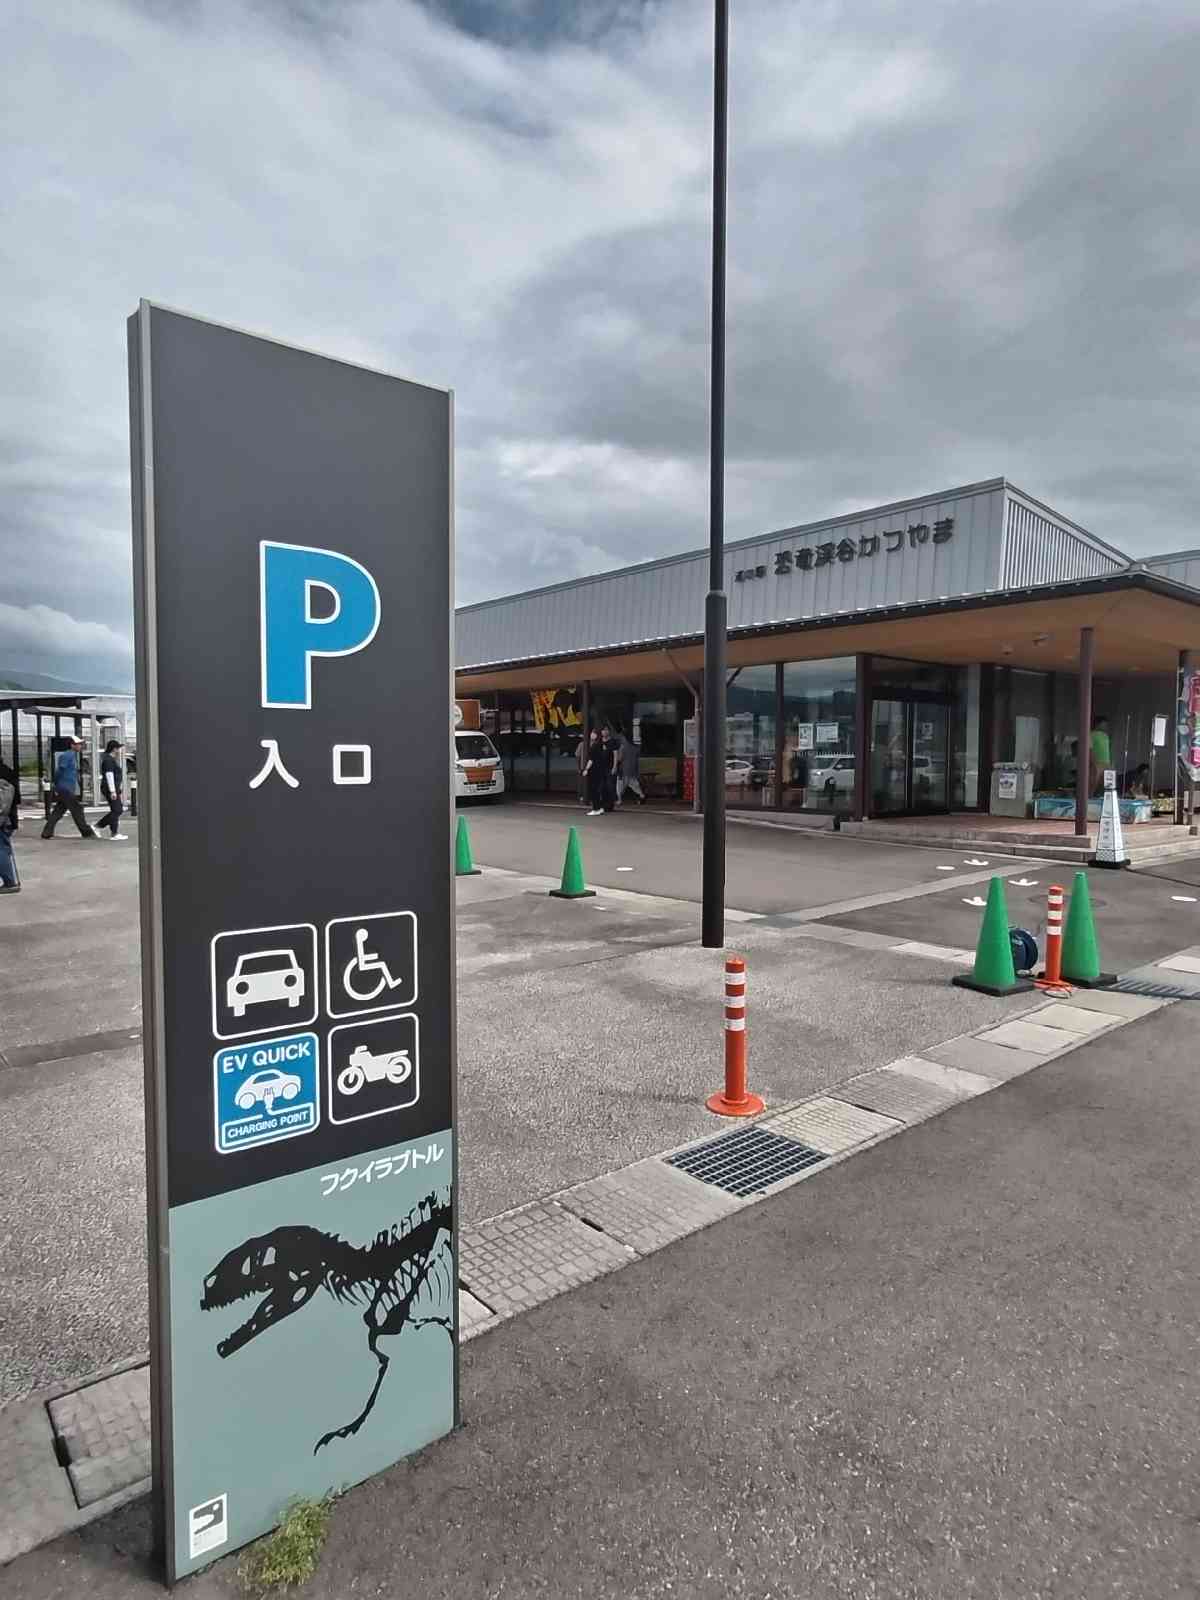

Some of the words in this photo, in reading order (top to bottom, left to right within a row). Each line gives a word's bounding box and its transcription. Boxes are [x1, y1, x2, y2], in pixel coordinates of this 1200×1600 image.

[259, 540, 381, 709] P
[249, 738, 372, 788] 入口
[222, 1053, 248, 1074] EV
[252, 1041, 311, 1066] QUICK
[227, 1119, 278, 1139] CHARGING
[280, 1111, 308, 1126] POINT
